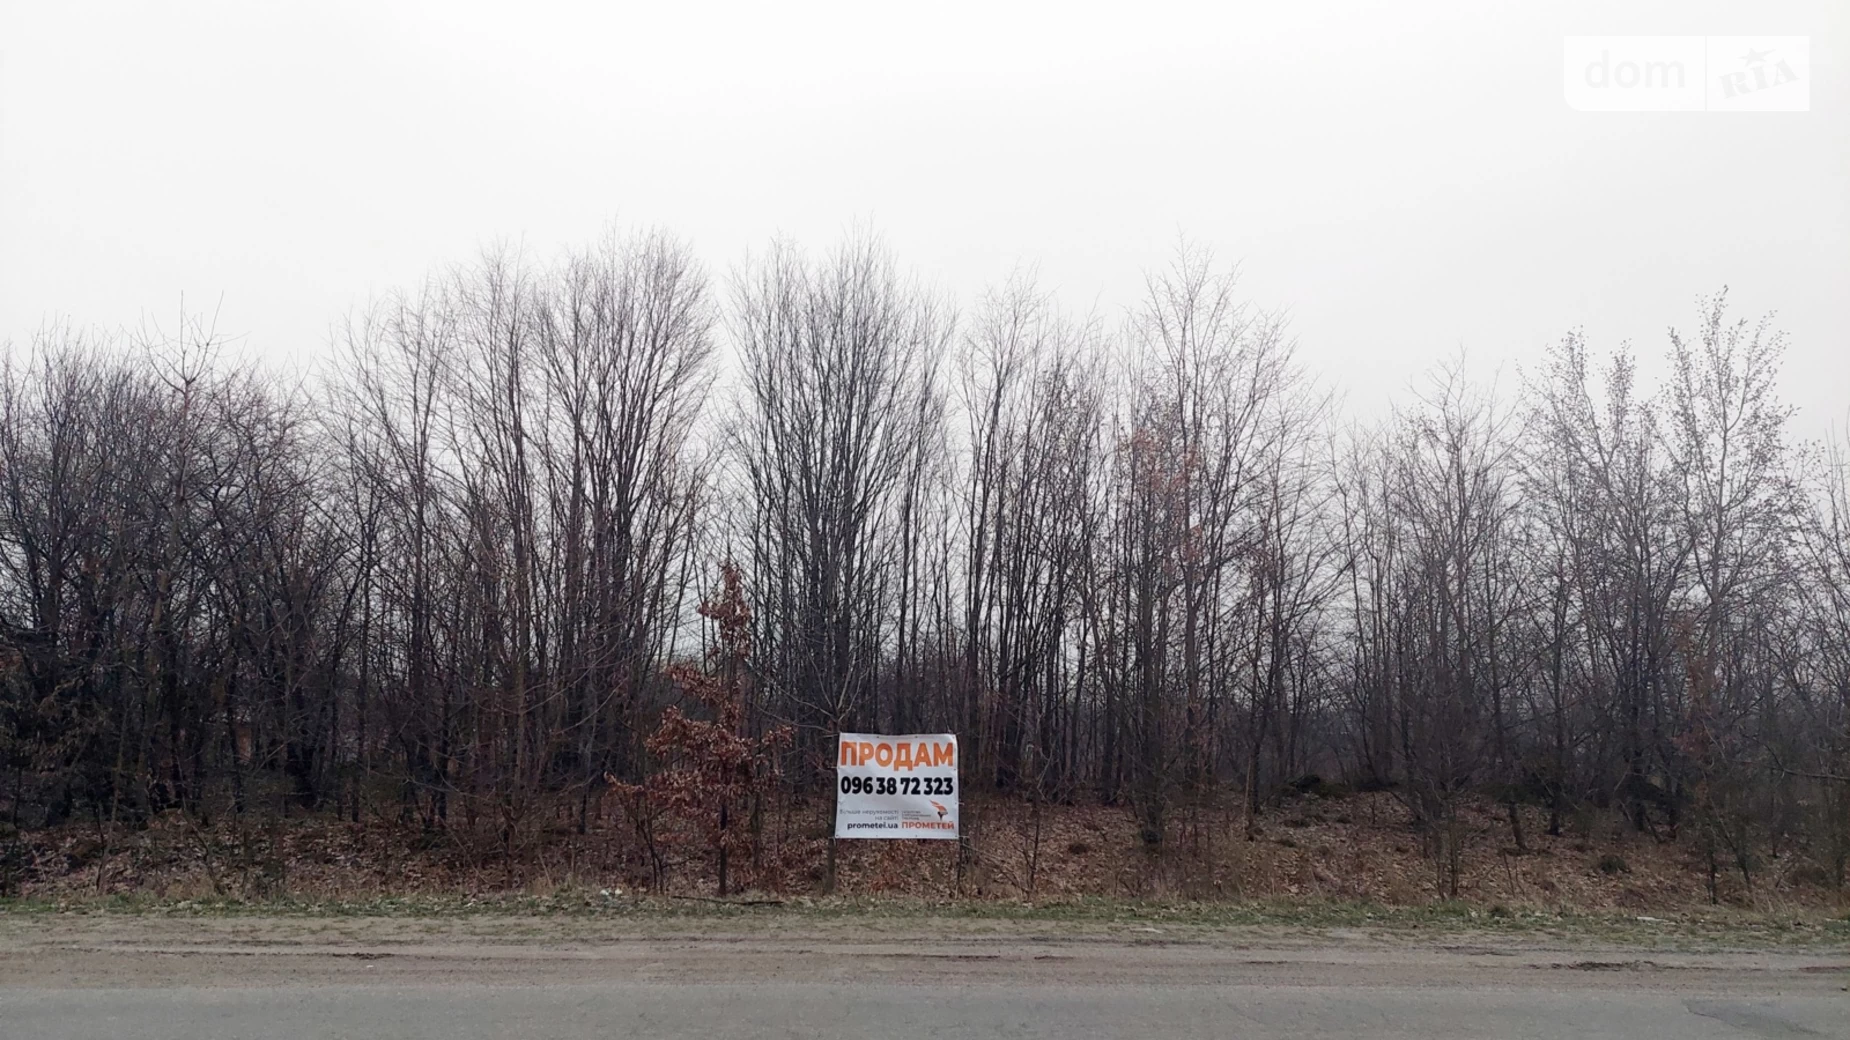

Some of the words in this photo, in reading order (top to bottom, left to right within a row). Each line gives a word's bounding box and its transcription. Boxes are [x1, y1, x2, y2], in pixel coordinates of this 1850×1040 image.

[841, 741, 954, 771] ПРОДАМ
[841, 776, 873, 794] 096
[876, 777, 897, 795] 38
[901, 777, 921, 795] 72
[924, 777, 954, 795] 323
[847, 822, 899, 830] prometei.ua
[902, 821, 955, 830] ПРОМЕТЕЙ
